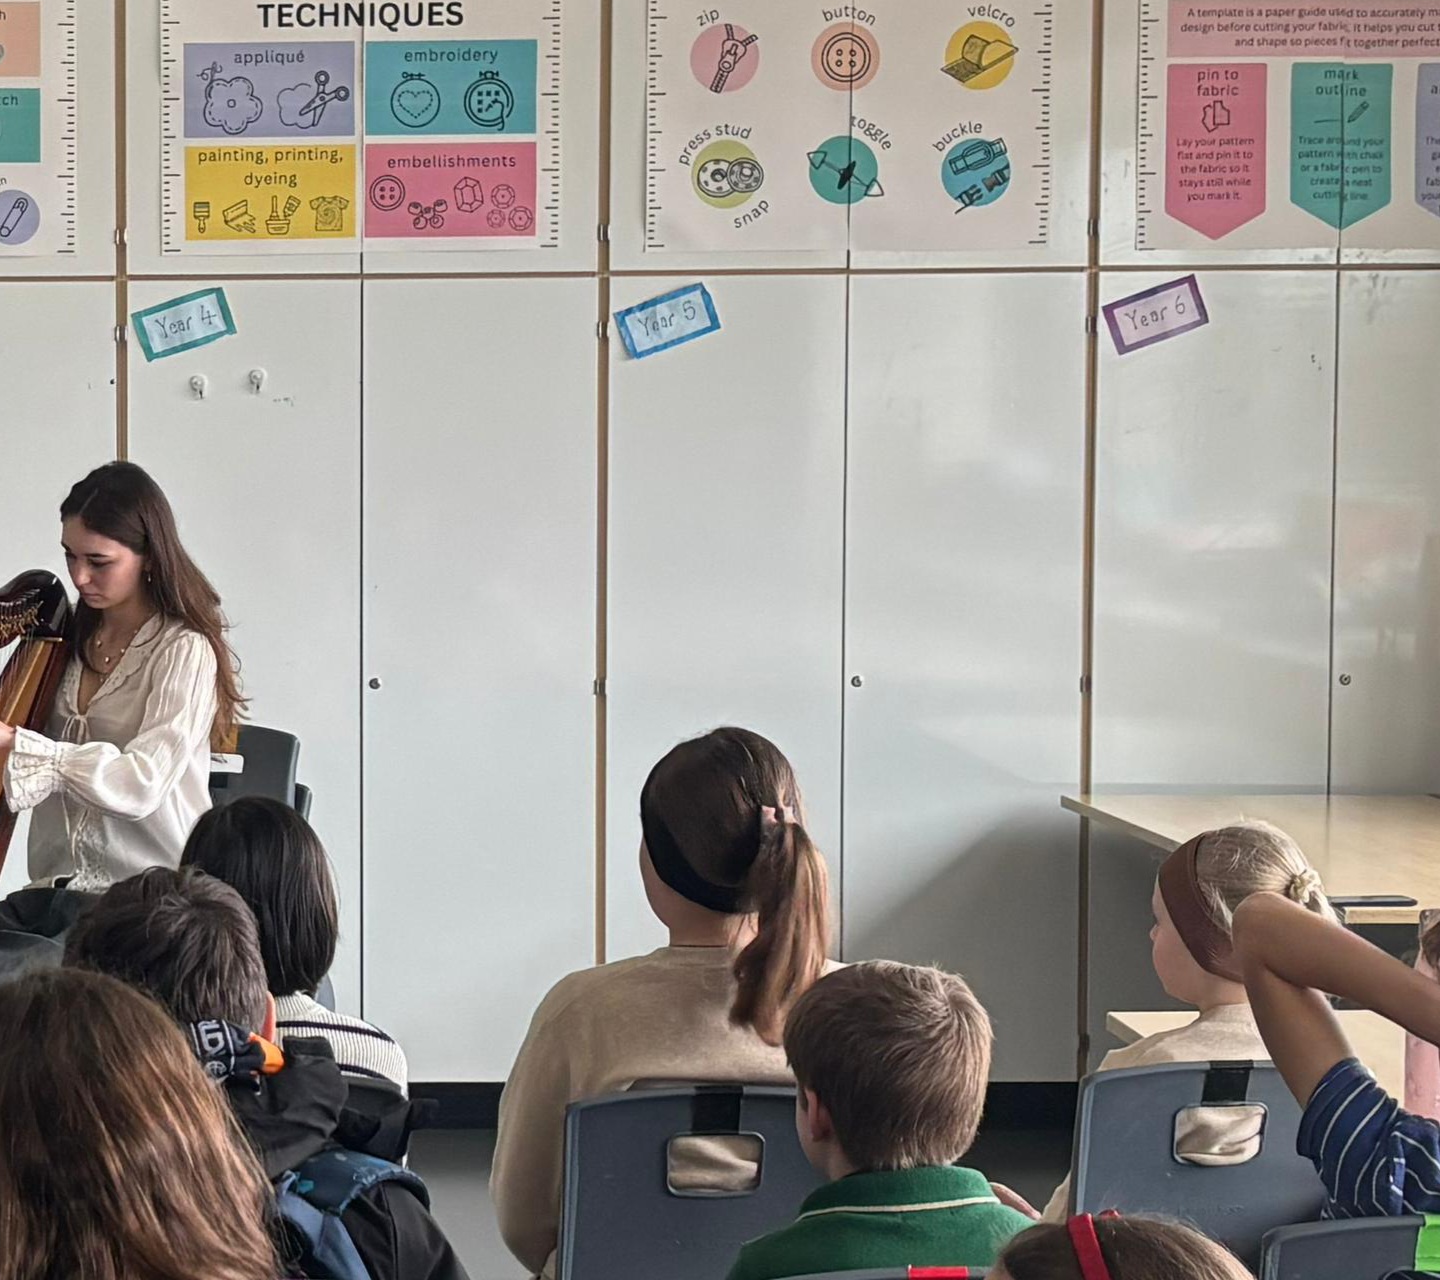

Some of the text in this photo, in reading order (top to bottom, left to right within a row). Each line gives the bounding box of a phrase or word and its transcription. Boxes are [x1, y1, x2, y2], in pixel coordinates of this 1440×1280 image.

[257, 2, 464, 31] TECHNIQUES
[696, 7, 720, 27] zip
[821, 5, 877, 26] button
[967, 4, 1016, 28] velcro
[1188, 8, 1195, 17] A
[1198, 8, 1243, 19] template
[1246, 8, 1254, 17] is
[1265, 8, 1295, 21] paper
[1298, 8, 1326, 19] guide
[1356, 9, 1367, 17] to
[1370, 8, 1425, 19] accurately
[1181, 23, 1214, 34] design
[1217, 23, 1251, 32] before
[1253, 23, 1290, 33] cutting
[1292, 24, 1315, 33] your
[1364, 23, 1393, 33] helps
[1395, 24, 1415, 34] you
[1417, 23, 1434, 31] cut
[1235, 38, 1254, 47] and
[1257, 38, 1287, 48] shape
[1304, 38, 1337, 48] pieces
[1354, 39, 1399, 49] together
[234, 49, 305, 67] appliqué
[404, 47, 498, 64] embroidery
[1198, 68, 1238, 82] pin to
[1324, 70, 1359, 80] mark
[1198, 84, 1239, 96] fabric
[849, 115, 893, 150] toggle
[932, 121, 983, 152] buckle
[1299, 136, 1324, 144] Trace
[678, 123, 753, 166] press stud
[1177, 138, 1254, 148] Lay your pattern
[197, 147, 343, 165] painting, printing,
[386, 154, 516, 169] embellishments
[1177, 151, 1193, 160] flat
[1196, 151, 1214, 160] and
[1216, 151, 1231, 160] pin
[1233, 151, 1240, 160] it
[1298, 150, 1334, 159] pattern
[1337, 151, 1357, 160] wth
[1180, 164, 1196, 173] the
[1199, 164, 1226, 173] fabric
[1243, 164, 1249, 172] it
[1301, 164, 1311, 172] or
[1372, 165, 1382, 173] to
[243, 171, 298, 188] dyeing
[1179, 179, 1204, 189] stays
[1226, 178, 1251, 186] while
[1187, 194, 1205, 202] you
[1207, 192, 1230, 200] mark
[733, 199, 770, 229] snap
[637, 300, 697, 337] Year 5
[1125, 294, 1187, 331] Year 6
[154, 305, 218, 340] Year 4
